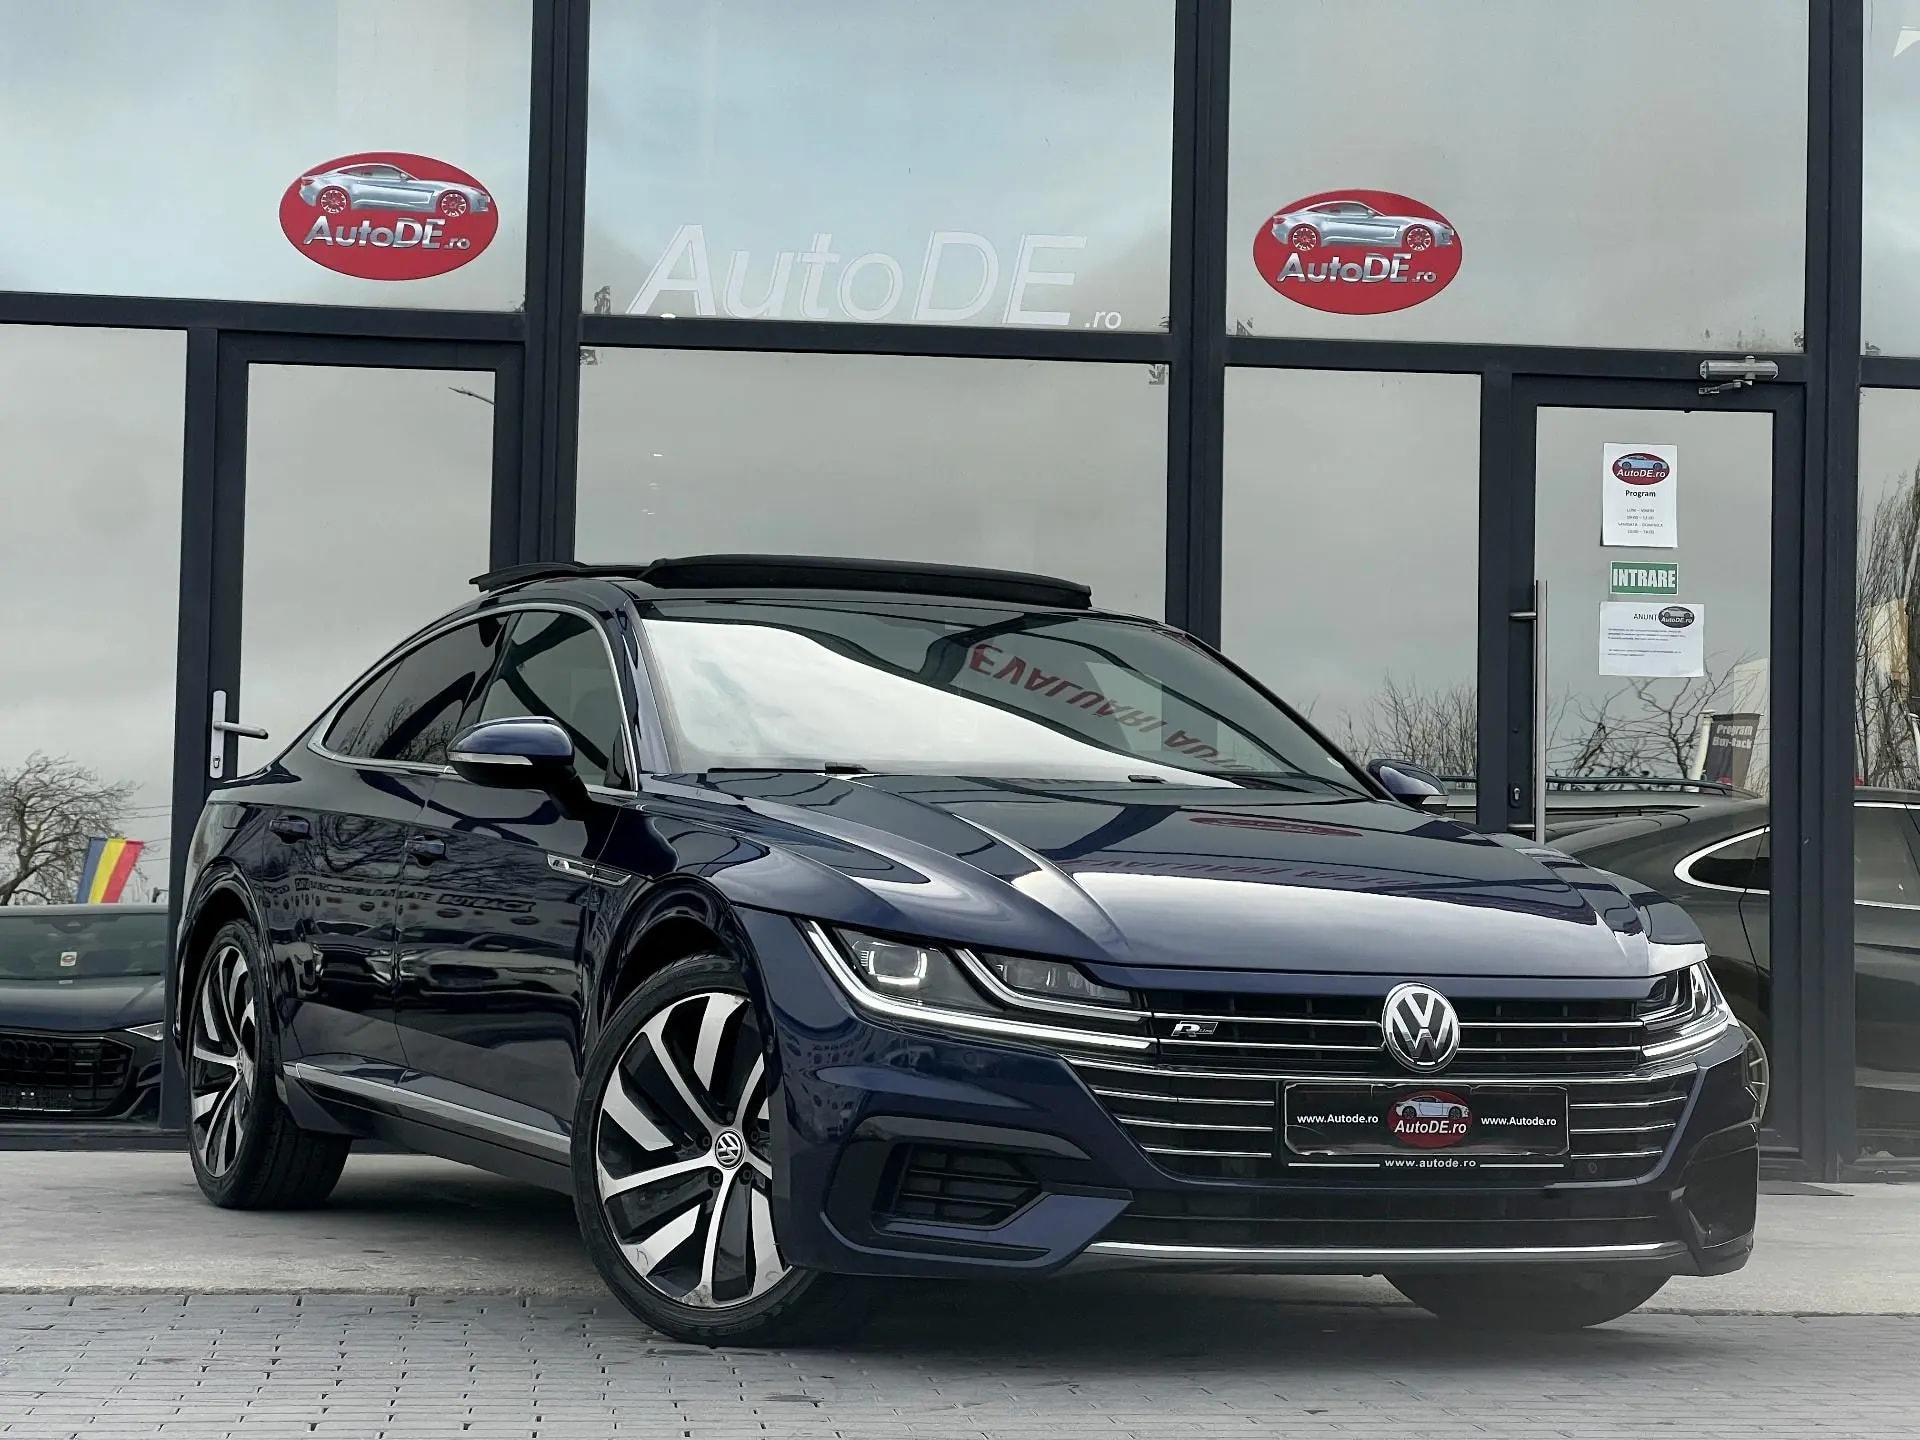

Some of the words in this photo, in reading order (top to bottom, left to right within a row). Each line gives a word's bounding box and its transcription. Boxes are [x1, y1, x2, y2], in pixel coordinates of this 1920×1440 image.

[1616, 468, 1666, 478] AutoDE.ro
[1625, 489, 1656, 498] Program
[1612, 567, 1676, 588] INTRARE
[1296, 1112, 1379, 1124] www.Autode.ro
[1480, 1116, 1557, 1127] www.Autode.ro
[1394, 1119, 1467, 1134] AutoDE.ro
[1385, 1158, 1477, 1169] www.autode.ro
